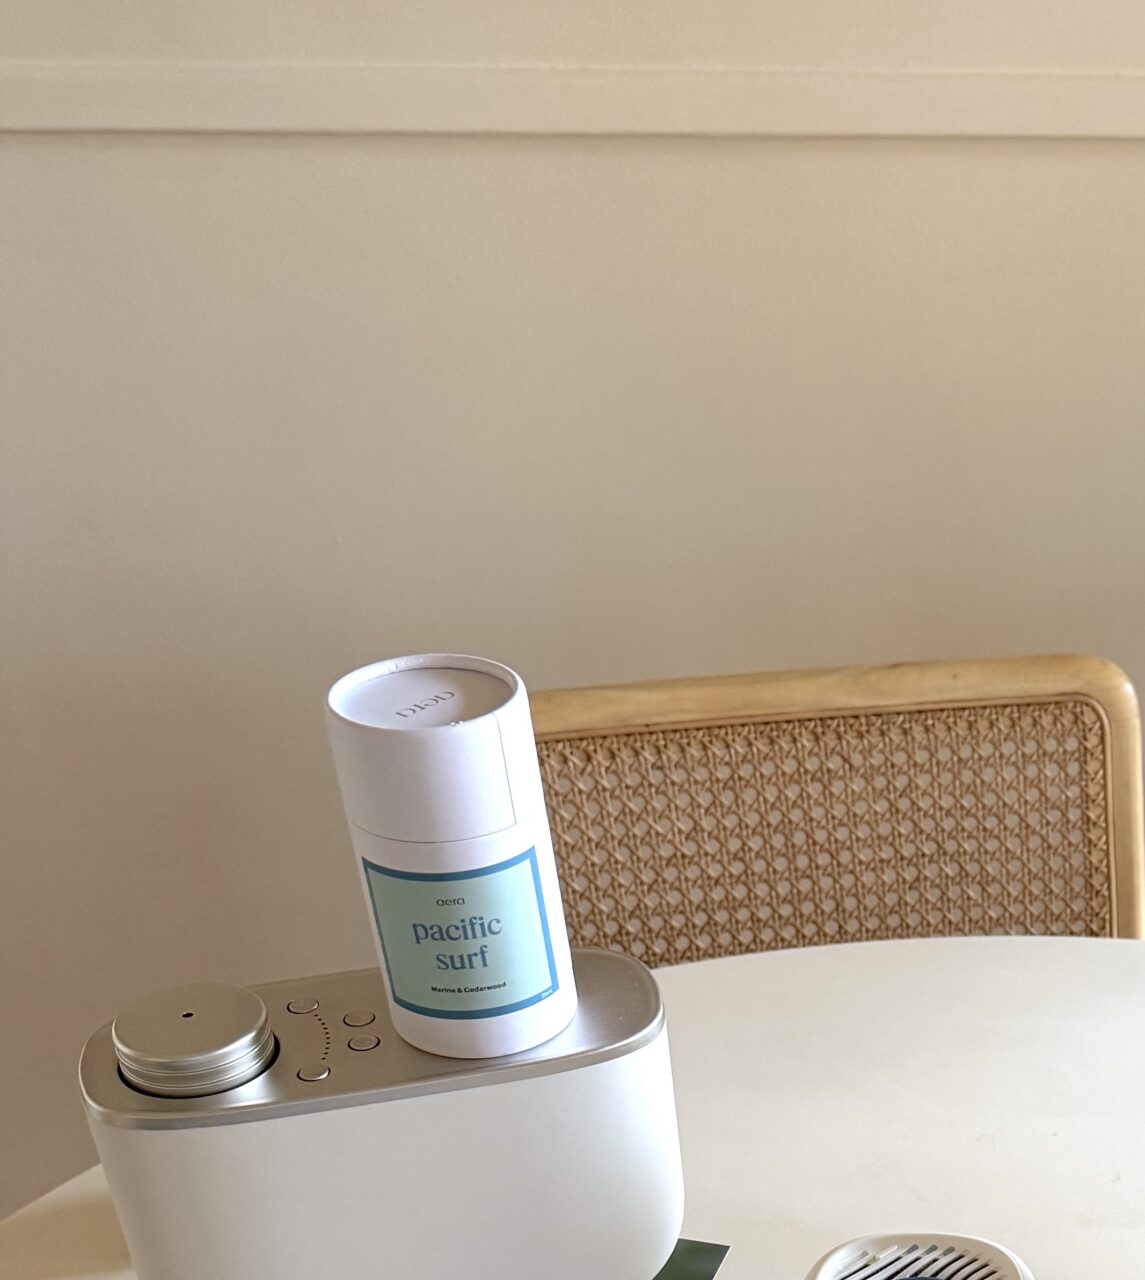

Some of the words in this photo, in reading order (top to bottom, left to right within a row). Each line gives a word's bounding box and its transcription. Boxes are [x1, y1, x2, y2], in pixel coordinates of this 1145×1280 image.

[395, 691, 455, 718] aera
[436, 897, 465, 907] aera
[412, 916, 503, 944] pacific
[436, 945, 488, 970] surf
[431, 986, 456, 994] Marine
[464, 981, 507, 993] Cedarwood
